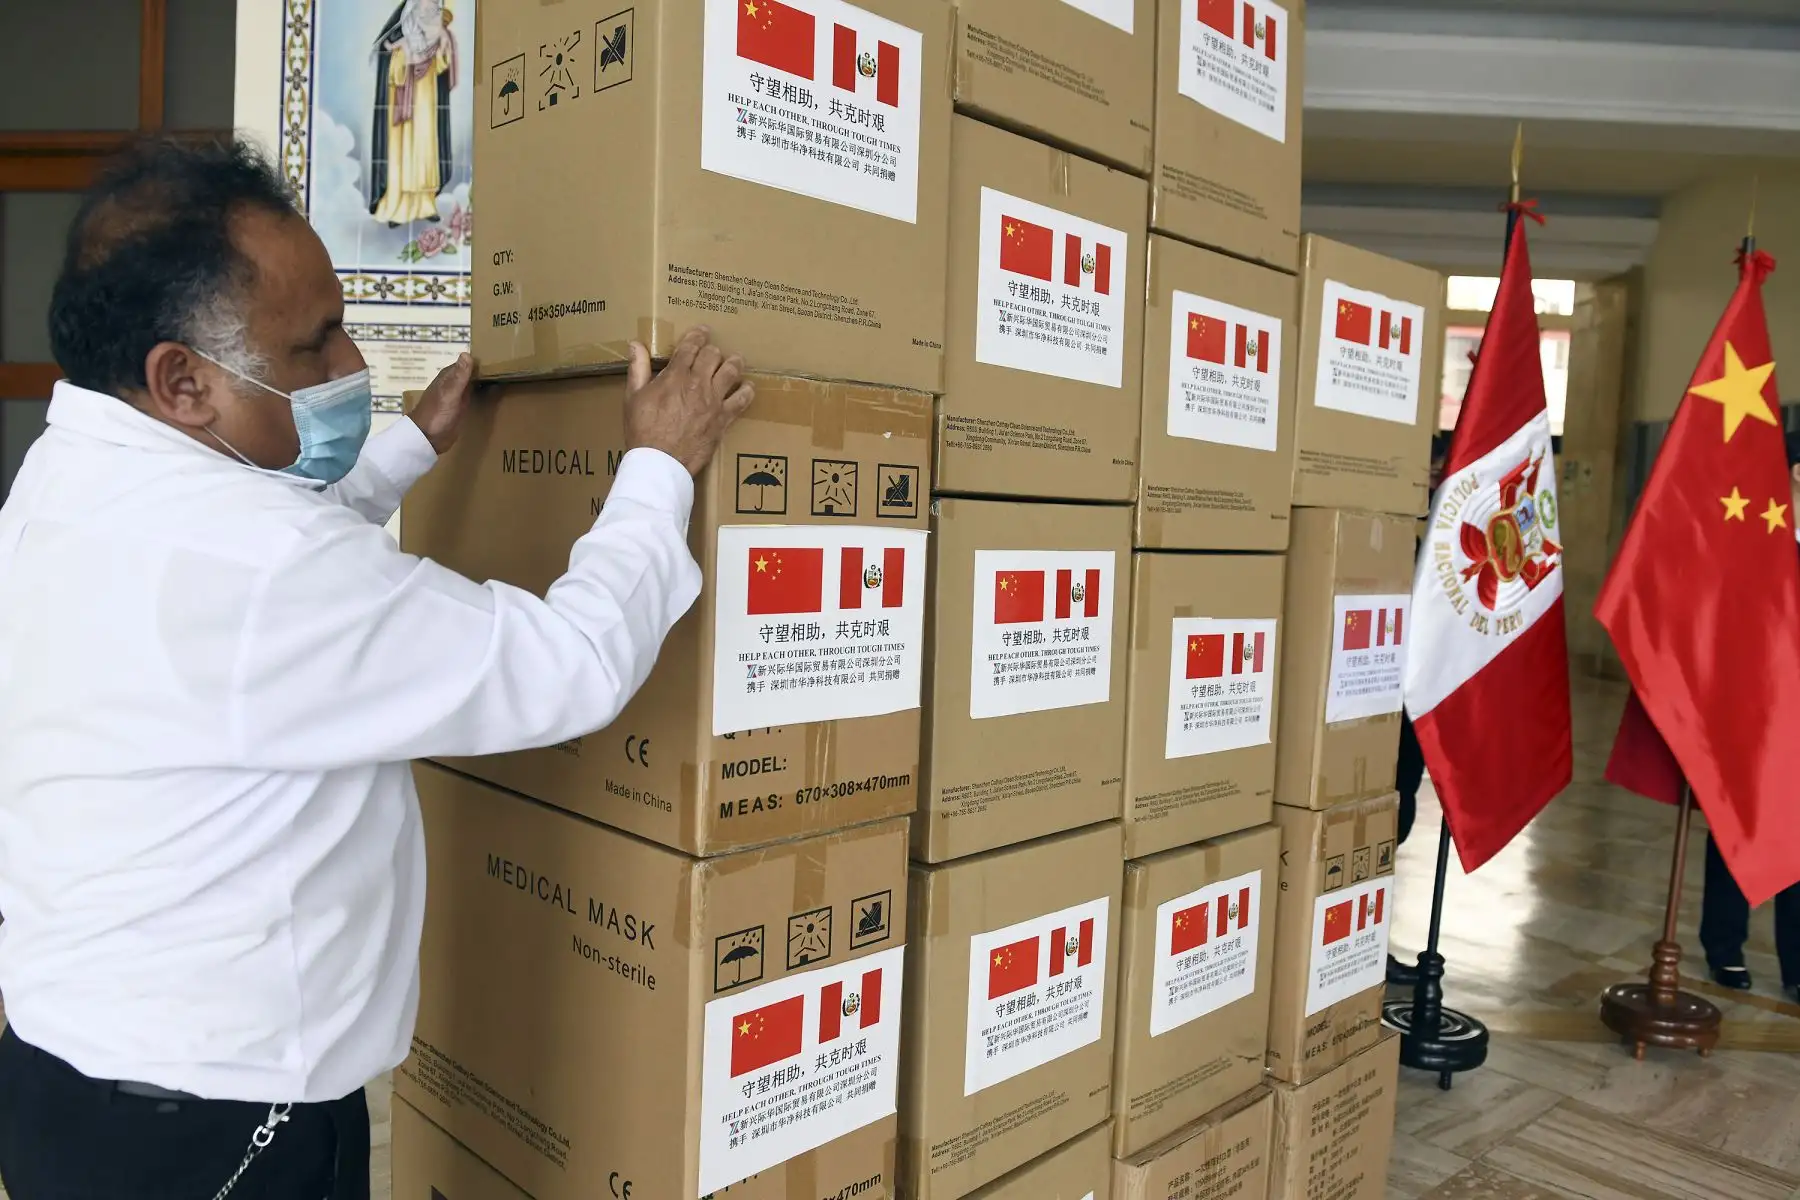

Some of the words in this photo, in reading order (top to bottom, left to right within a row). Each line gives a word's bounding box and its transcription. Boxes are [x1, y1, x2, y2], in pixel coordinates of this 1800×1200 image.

[749, 70, 885, 133] 守望相助，共克时艰
[728, 92, 751, 108] HELP
[752, 100, 777, 115] EACH
[810, 117, 850, 138] THROUGH
[851, 130, 877, 146] TOUGH
[878, 138, 901, 153] TIMES
[736, 124, 756, 143] 携手
[760, 131, 859, 172] 深圳市华净科技有限公司
[862, 160, 896, 182] 共同捐赠
[747, 111, 897, 168] 新兴际华国际贸易有限公司深圳分公司
[493, 249, 514, 266] QTY:
[493, 281, 514, 296] G.W:
[668, 263, 712, 278] Manufacturer:
[714, 271, 742, 284] Shenzhen
[764, 280, 780, 290] Clean
[780, 283, 801, 294] Science
[801, 287, 812, 296] and
[811, 289, 840, 303] Technology
[668, 274, 697, 287] Address:
[717, 282, 740, 296] Building
[764, 291, 785, 302] Science
[1007, 278, 1101, 316] 守望相助，共克时艰
[492, 311, 521, 327] MEAS:
[833, 312, 858, 324] Shenzhen
[993, 298, 1009, 308] HELP
[1009, 301, 1026, 312] EACH
[1048, 310, 1076, 323] THROUGH
[1076, 316, 1095, 327] TOUGH
[1095, 321, 1111, 331] TIMES
[946, 414, 975, 424] Manufacturer:
[946, 423, 965, 432] Address:
[503, 450, 595, 475] MEDICAL
[1435, 471, 1480, 530] POLICIA
[1434, 542, 1469, 616] NACIONAL
[758, 618, 890, 643] 守望相助，共克时艰
[1001, 624, 1090, 646] 守望相助，共克时艰
[1469, 611, 1489, 636] DEL
[738, 651, 761, 661] HELP
[762, 650, 786, 660] EACH
[818, 645, 856, 656] THROUGH
[857, 643, 882, 653] TOUGH
[883, 642, 905, 651] TIMES
[756, 653, 901, 677] 新兴际华国际贸易有限公司深圳分公司
[988, 652, 1003, 660] HELP
[1003, 651, 1019, 659] EACH
[1040, 647, 1067, 656] THROUGH
[1066, 646, 1084, 654] TOUGH
[745, 679, 765, 694] 携手
[770, 671, 865, 692] 深圳市华净科技有限公司
[868, 667, 900, 682] 共同捐赠
[721, 755, 787, 780] MODEL:
[605, 778, 631, 800] Made
[632, 788, 641, 802] in
[643, 792, 673, 813] China
[487, 853, 577, 915] MEDICAL
[588, 897, 655, 950] MASK
[573, 935, 656, 991] Non-sterile
[995, 973, 1084, 1019] 守望相助，共克时艰
[741, 1035, 868, 1100] 守望相助，共克时艰
[722, 1107, 743, 1123] HELP
[744, 1098, 767, 1114] EACH
[797, 1072, 834, 1093] THROUGH
[835, 1062, 860, 1079] TOUGH
[860, 1054, 882, 1069] TIMES
[739, 1066, 878, 1131] 新兴际华国际贸易有限公司深圳分公司
[729, 1131, 747, 1150] 携手
[751, 1093, 843, 1141] 深圳市华净科技有限公司
[845, 1079, 877, 1103] 共同捐赠
